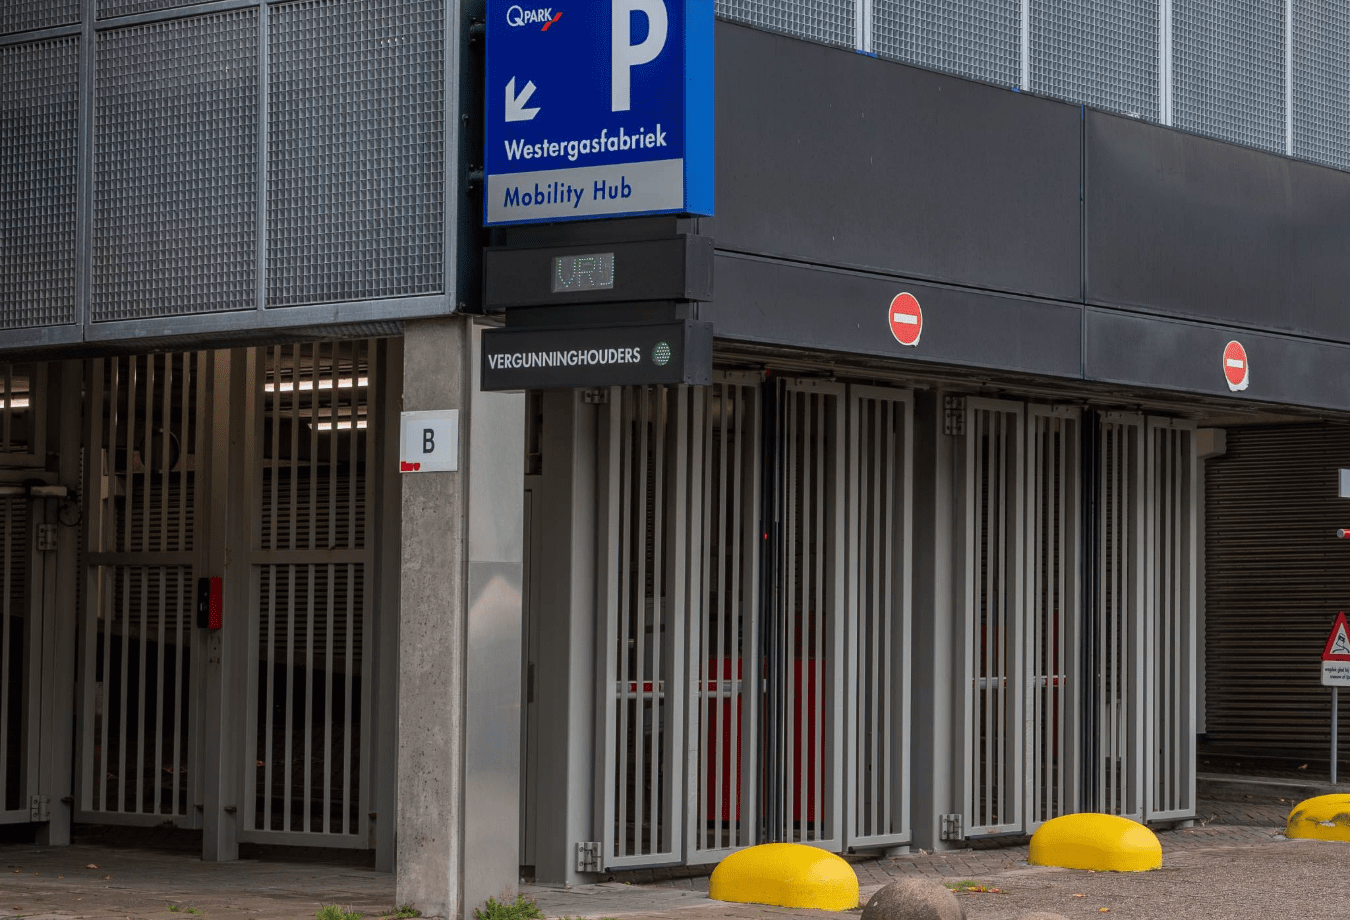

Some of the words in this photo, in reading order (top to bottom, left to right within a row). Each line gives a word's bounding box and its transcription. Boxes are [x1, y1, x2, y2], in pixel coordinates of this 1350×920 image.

[611, 0, 668, 112] P
[504, 123, 667, 161] Westergasfabriek
[503, 181, 584, 208] Mobility
[593, 175, 632, 201] Hub
[488, 347, 641, 369] VERGUNNINGHOUDERS
[422, 428, 435, 454] B
